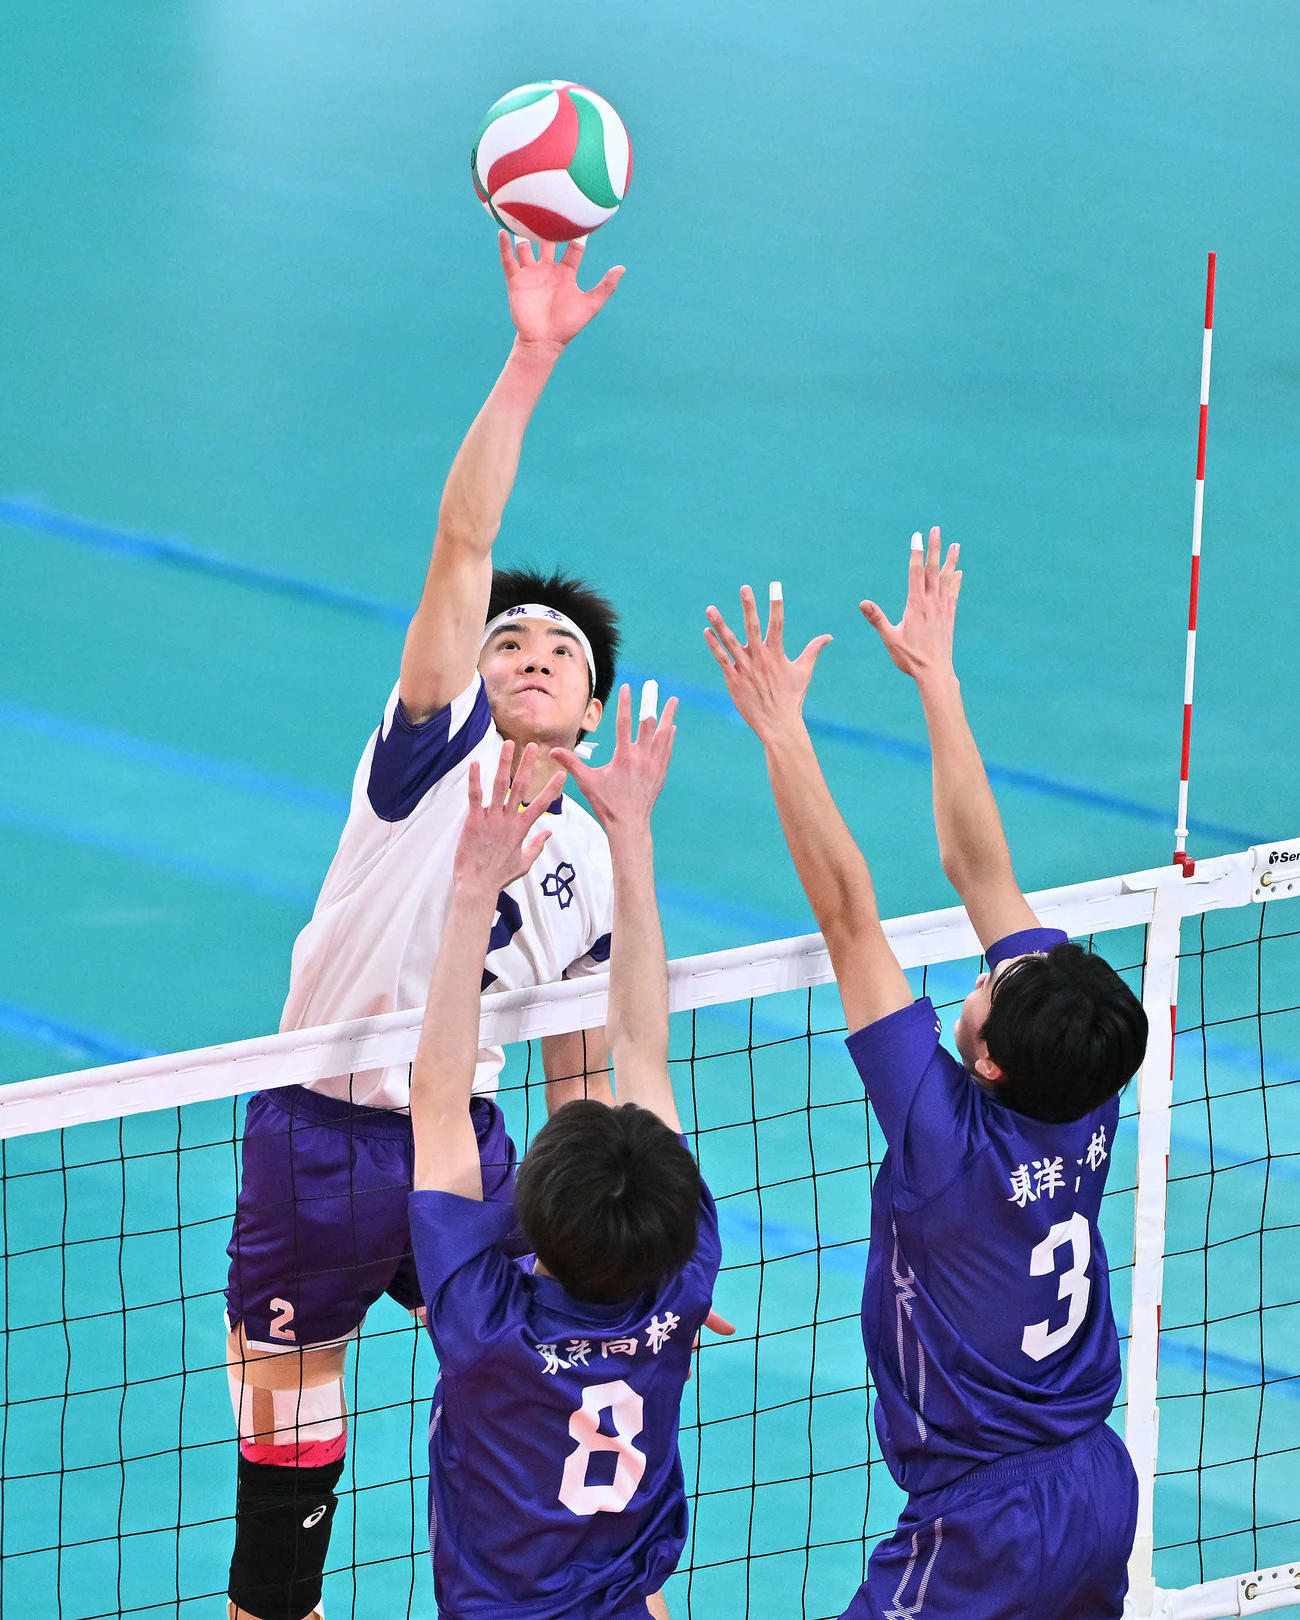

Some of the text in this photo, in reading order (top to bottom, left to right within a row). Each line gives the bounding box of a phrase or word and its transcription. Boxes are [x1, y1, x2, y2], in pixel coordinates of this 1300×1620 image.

[1008, 1125, 1107, 1207] 東洋校
[269, 1297, 296, 1341] 2
[1021, 1212, 1090, 1361] 3
[558, 1380, 646, 1516] 8
